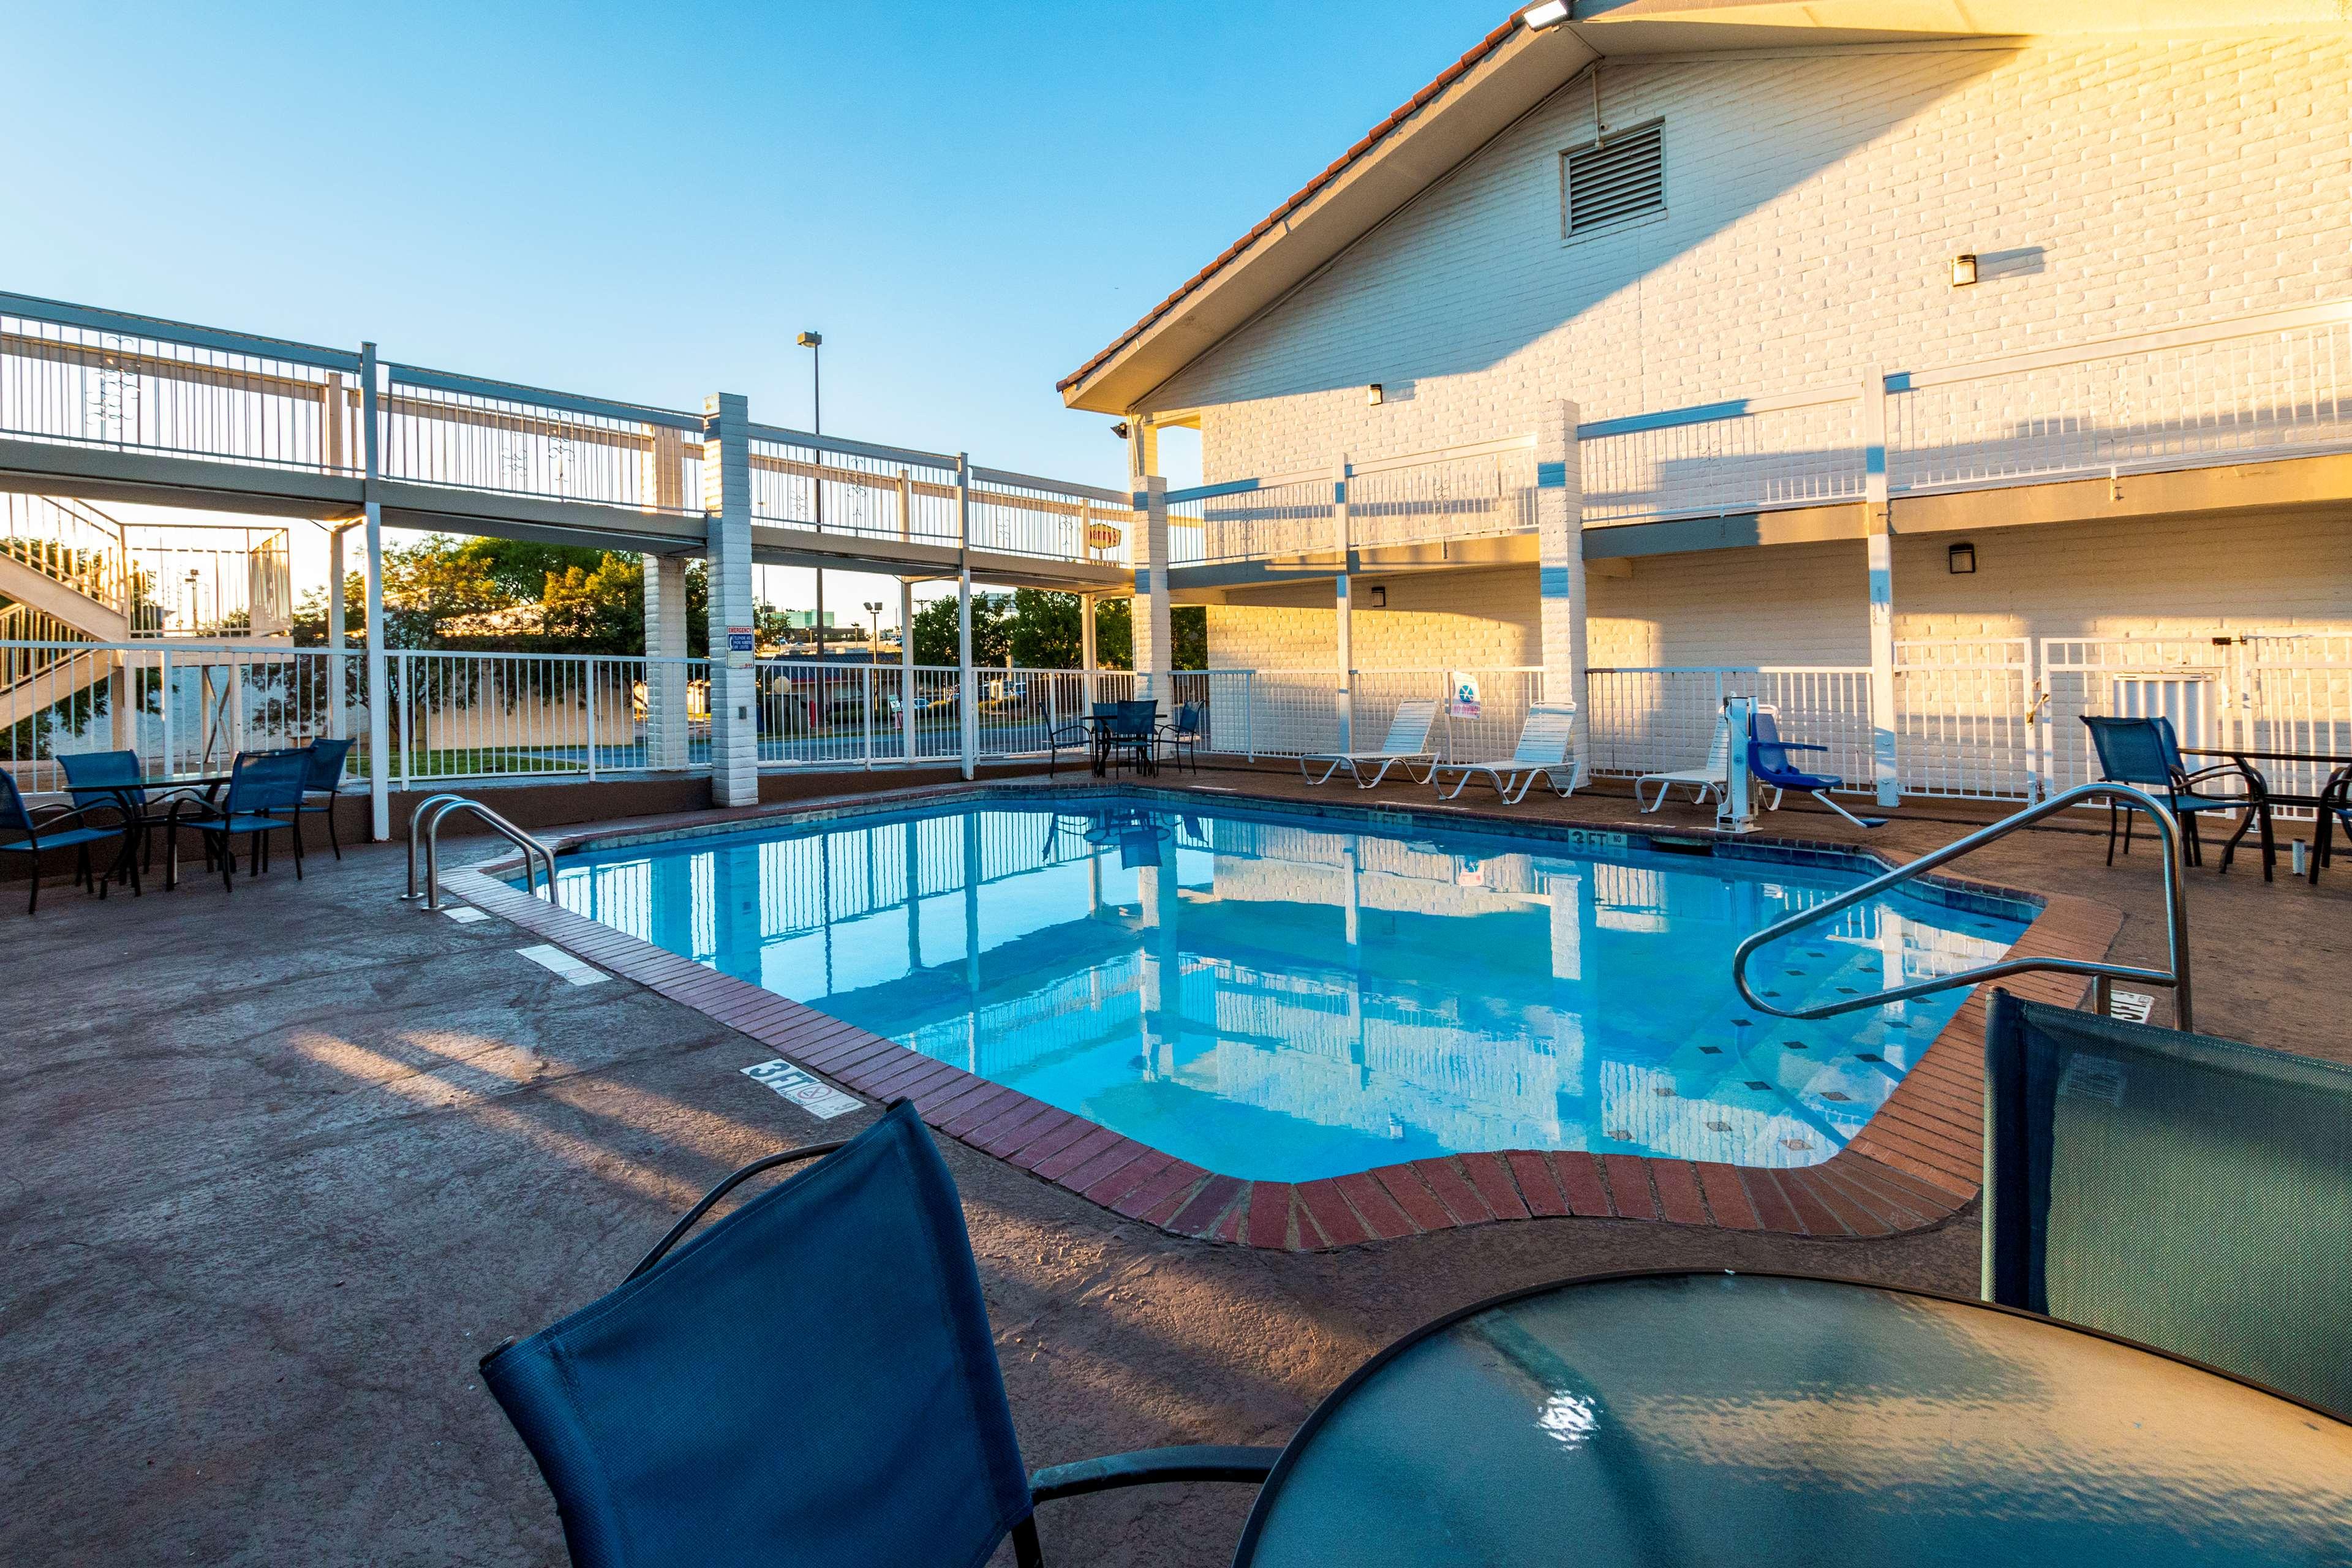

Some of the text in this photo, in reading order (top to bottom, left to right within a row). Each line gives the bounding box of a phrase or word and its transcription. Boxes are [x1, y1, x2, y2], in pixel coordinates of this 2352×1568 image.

[1453, 705, 1461, 715] NO
[1588, 832, 1607, 846] FT
[749, 1063, 791, 1077] 3
